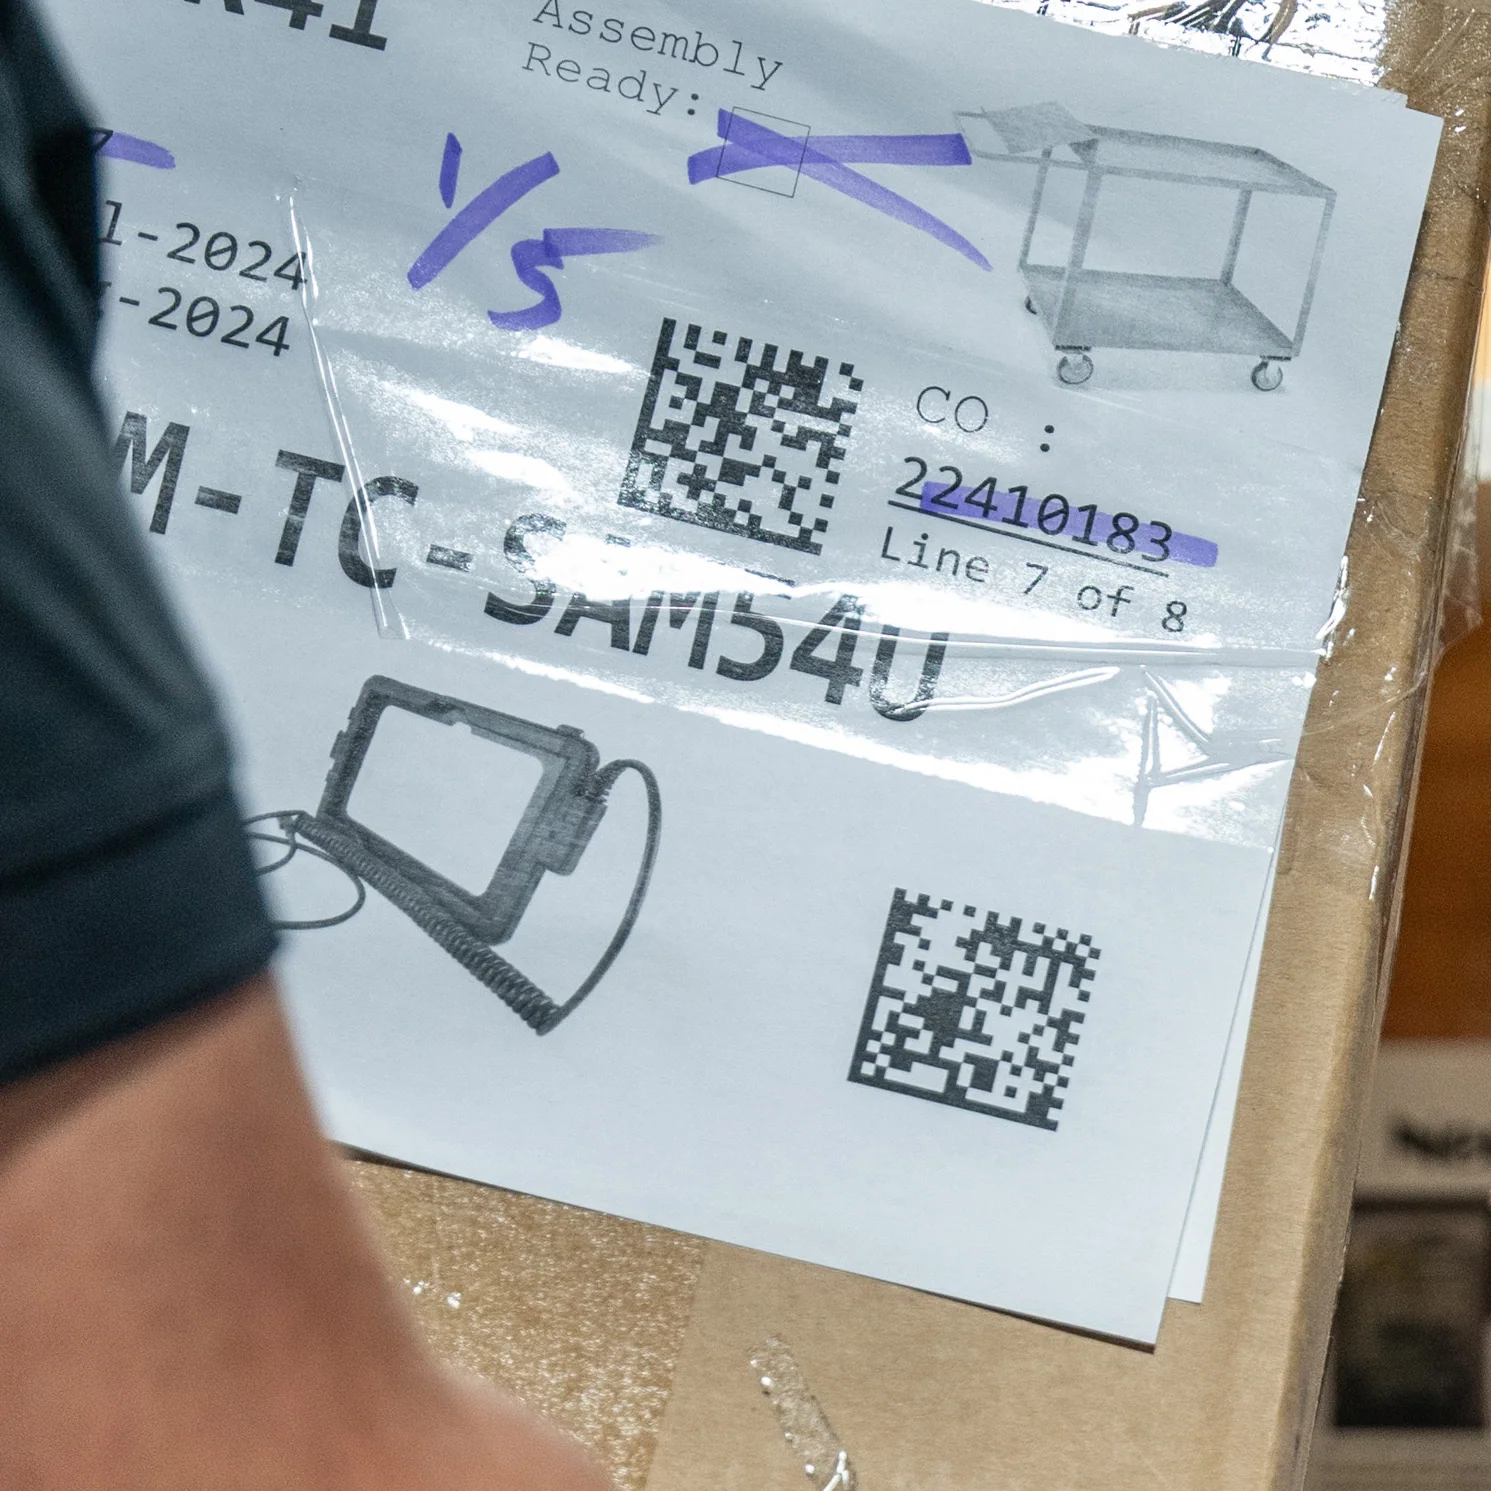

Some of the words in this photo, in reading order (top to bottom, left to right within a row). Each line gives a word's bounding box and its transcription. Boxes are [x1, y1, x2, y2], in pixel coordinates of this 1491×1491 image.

[522, 42, 699, 116] Ready:
[533, 0, 783, 91] Assembly
[407, 132, 664, 331] 1/5
[916, 386, 989, 433] CO
[895, 456, 1173, 565] 22410183
[880, 526, 990, 583] Line
[1023, 562, 1049, 595] 7
[1077, 585, 1134, 617] of
[1161, 600, 1188, 633] 8
